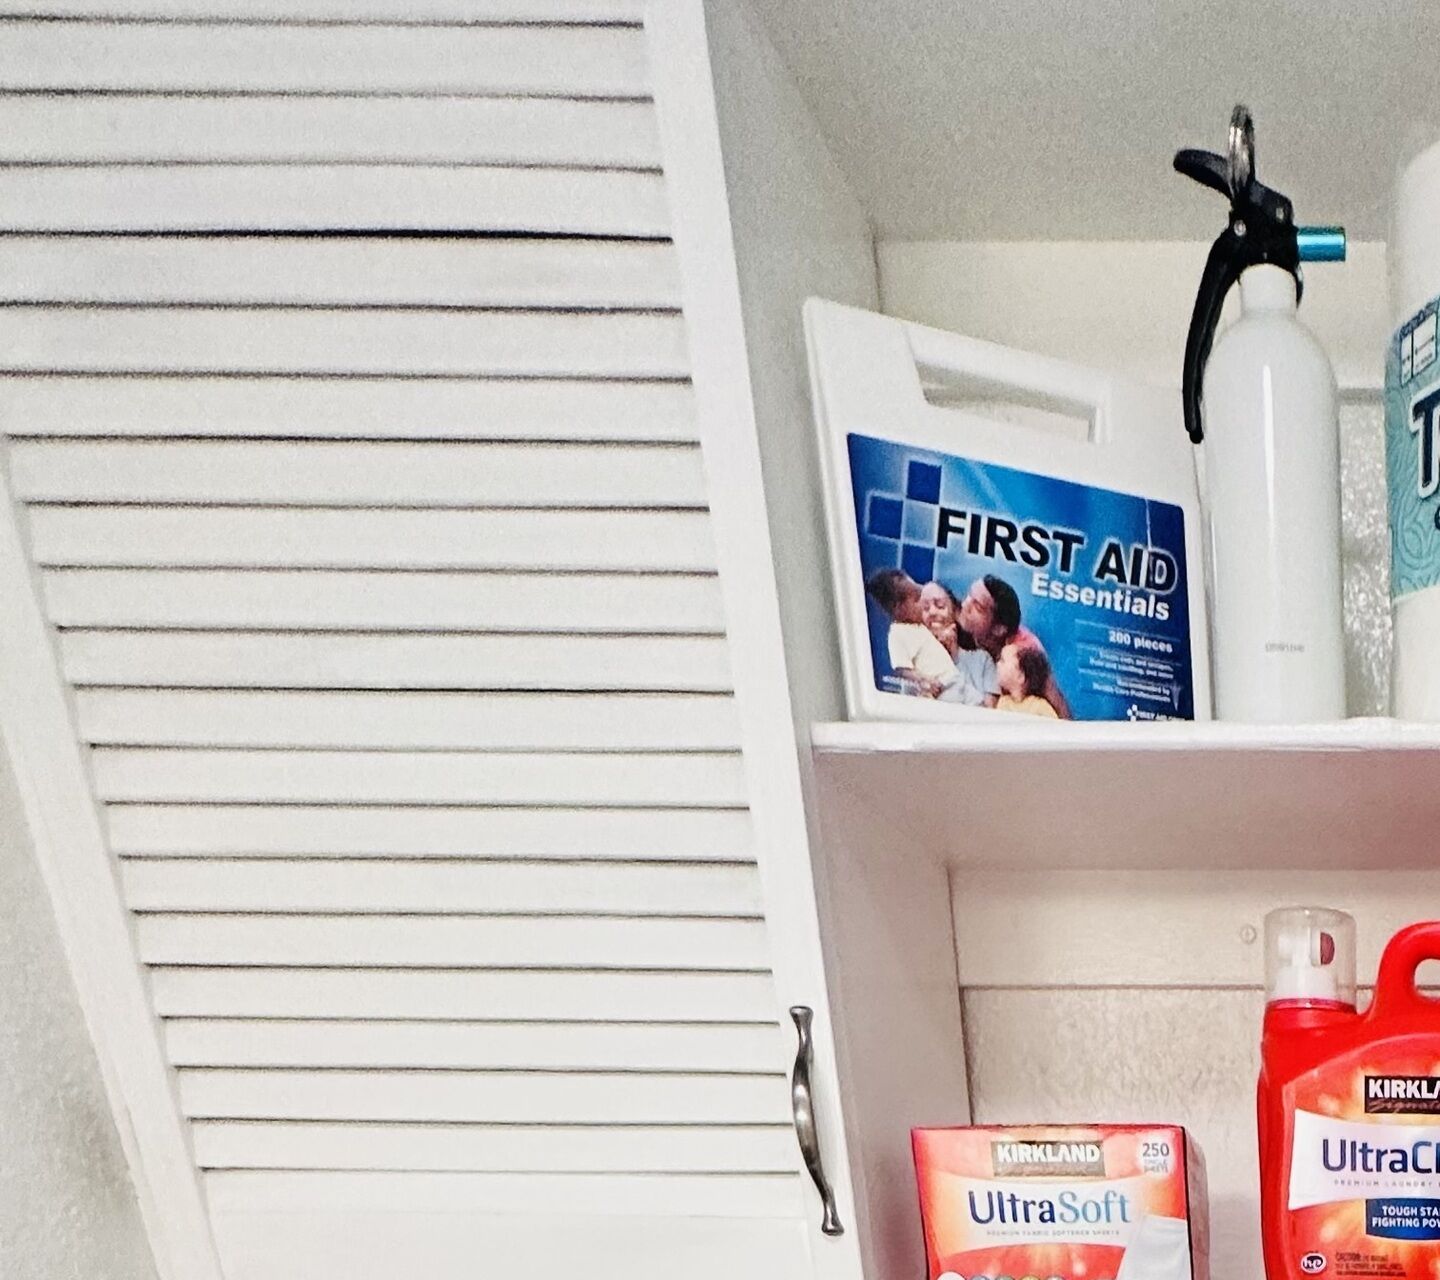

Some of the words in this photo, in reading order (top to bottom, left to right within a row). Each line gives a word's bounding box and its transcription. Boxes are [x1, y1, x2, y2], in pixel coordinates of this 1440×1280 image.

[936, 507, 1084, 573] FIRST
[1095, 542, 1177, 593] AID
[1031, 574, 1170, 621] Essentials
[1109, 630, 1131, 645] 200
[1134, 637, 1173, 653] pieces
[998, 1144, 1100, 1163] KIRKLAND
[1142, 1142, 1169, 1157] 250
[968, 1190, 1131, 1225] UltraSoft
[1382, 1205, 1418, 1216] TOUGH
[1371, 1217, 1420, 1228] FIGHTING
